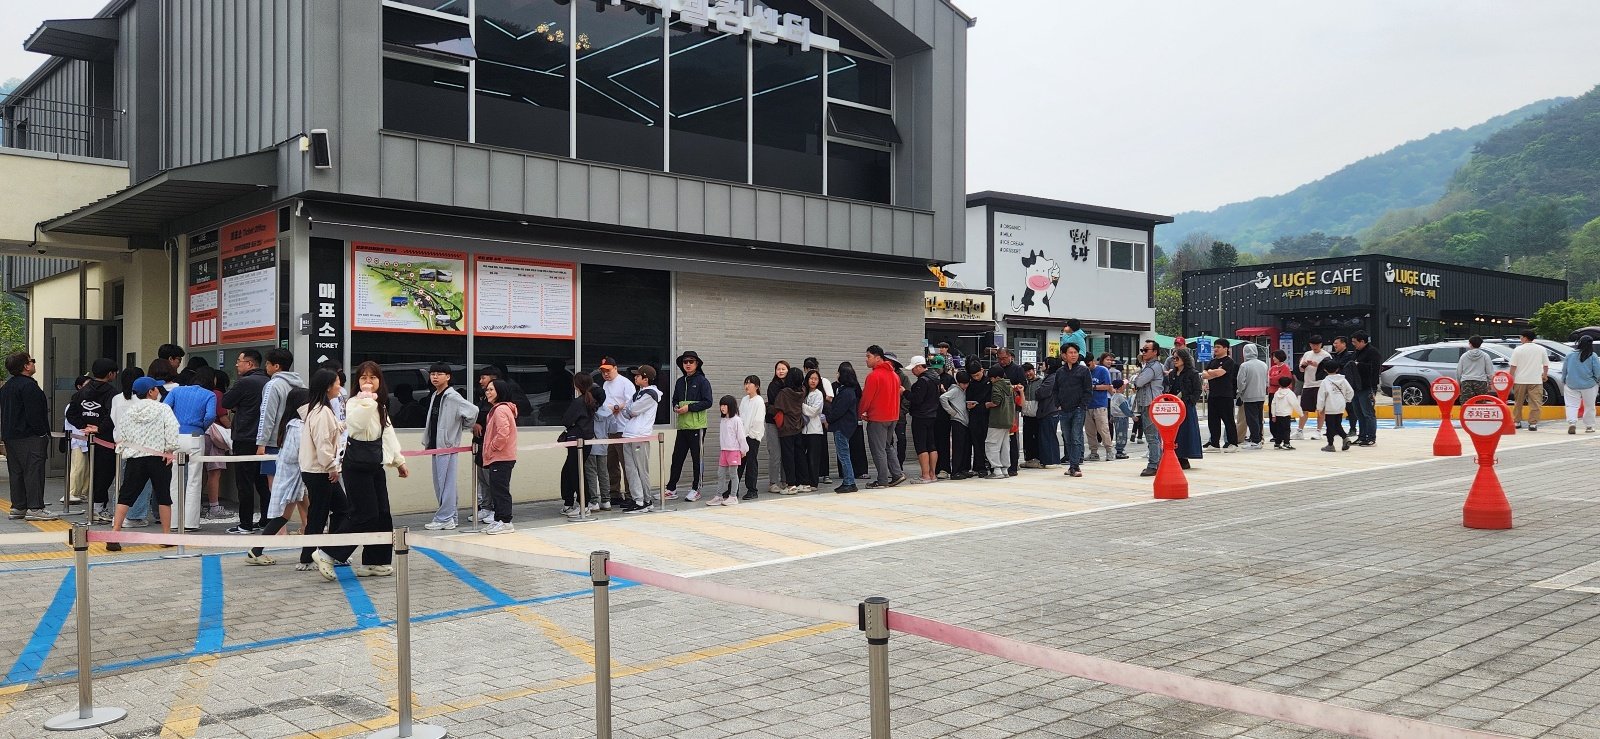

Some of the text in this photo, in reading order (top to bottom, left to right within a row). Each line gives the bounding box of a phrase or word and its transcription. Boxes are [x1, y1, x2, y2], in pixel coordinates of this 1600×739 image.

[1273, 268, 1363, 288] LUGE CAFE
[1395, 269, 1440, 288] LUGE CAFE
[1332, 285, 1351, 296] 카페
[319, 283, 336, 337] 매표소
[1467, 410, 1499, 419] 주차금지
